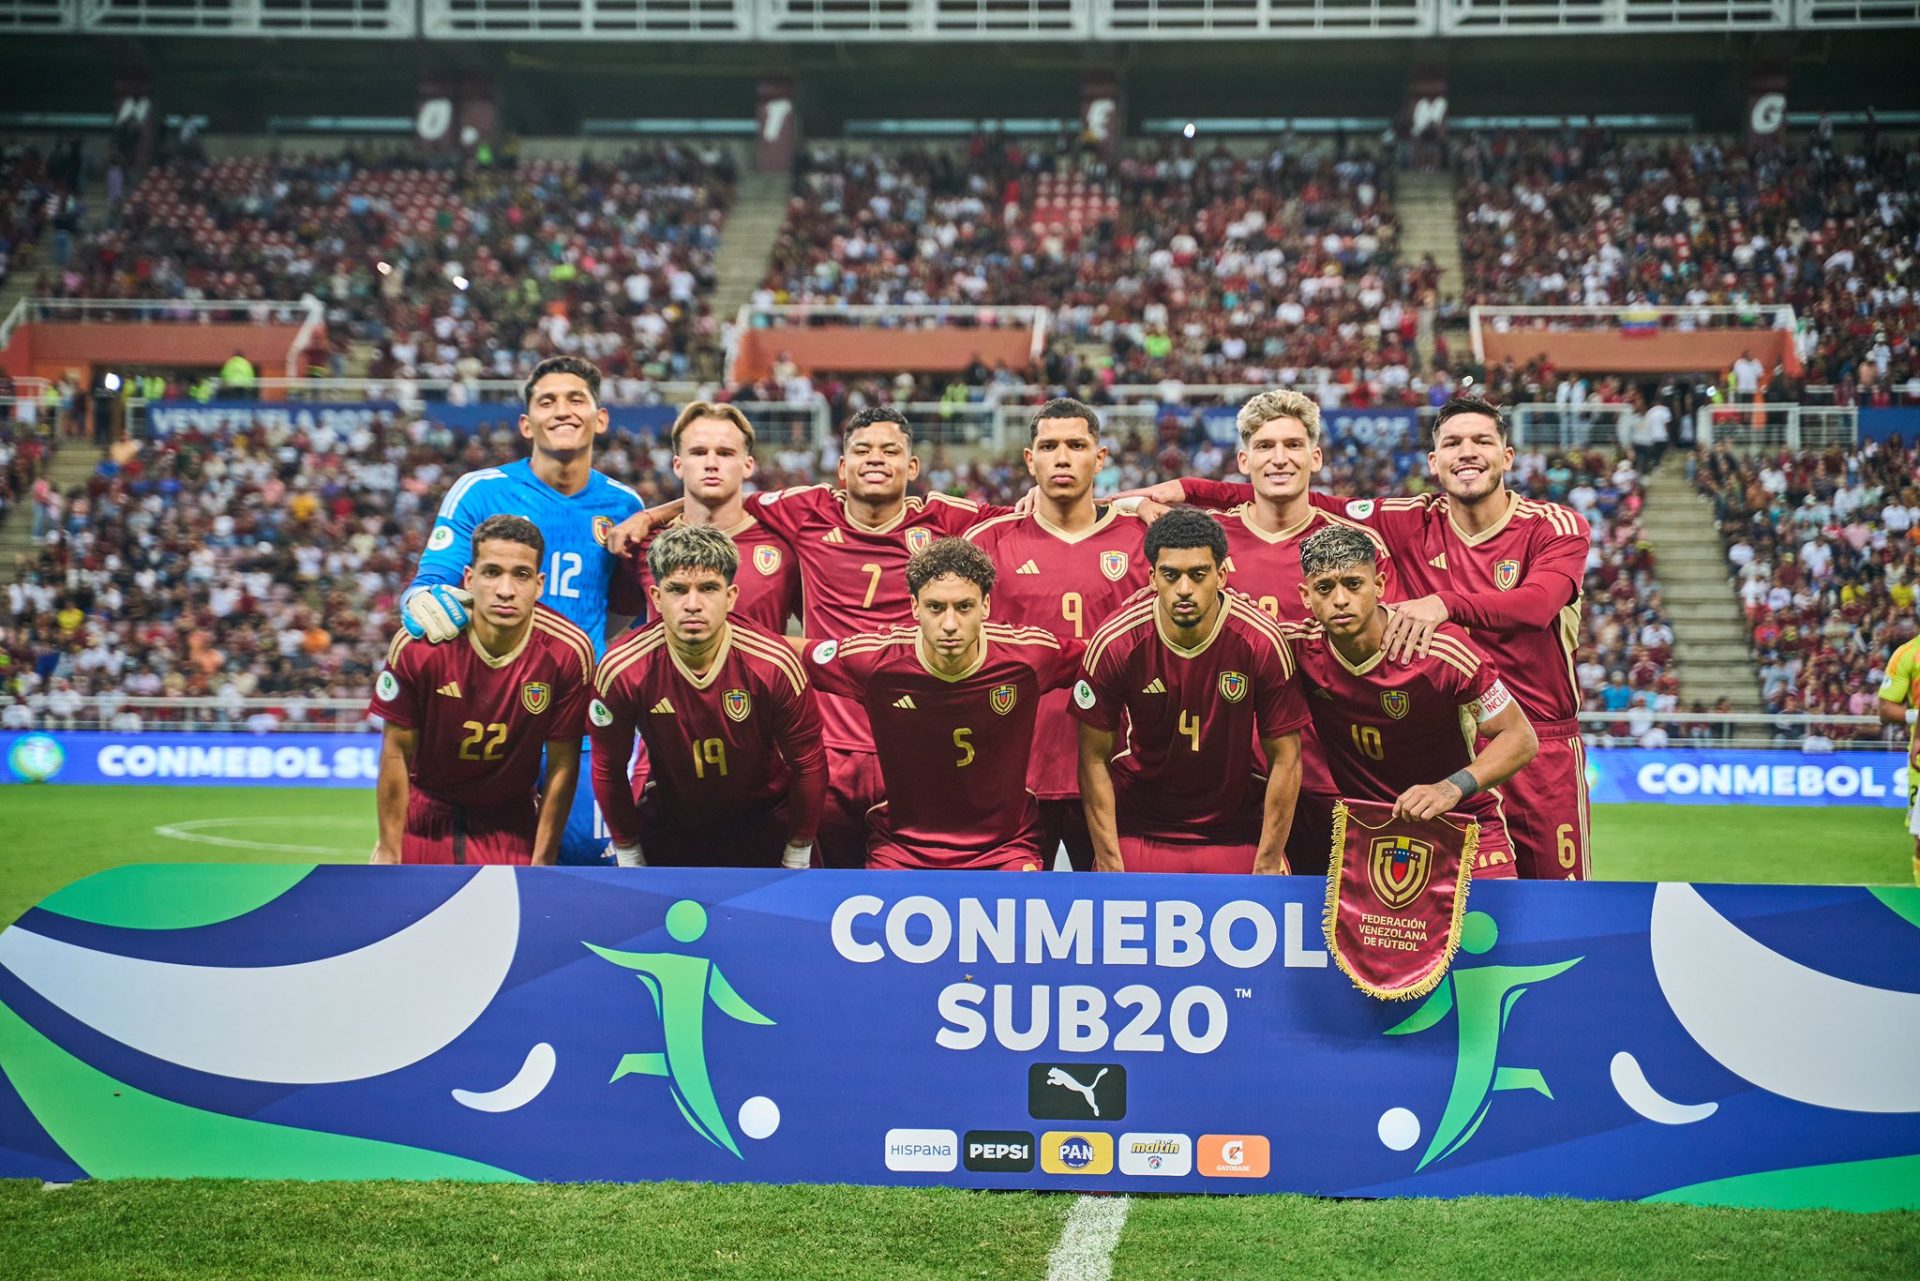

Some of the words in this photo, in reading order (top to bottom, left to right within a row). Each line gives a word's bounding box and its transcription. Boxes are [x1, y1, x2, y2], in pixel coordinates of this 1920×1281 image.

[1751, 93, 1786, 134] G
[551, 551, 582, 598] 12
[861, 563, 882, 608] 7
[1062, 592, 1083, 637] 9
[458, 720, 508, 761] 22
[952, 727, 975, 767] 5
[1178, 709, 1199, 752] 4
[1351, 723, 1384, 761] 10
[97, 744, 330, 778] CONMEBOL
[692, 737, 728, 778] 19
[1637, 762, 1886, 797] CONMEBOL
[1556, 823, 1576, 869] 6
[830, 895, 1329, 968] CONMEBOL
[1359, 924, 1428, 941] VENEZOLANA
[1361, 912, 1427, 930] FEDERACIÓN
[1363, 936, 1377, 946] DE
[1378, 938, 1419, 952] FÚTBOL
[935, 982, 1228, 1054] SUB20
[969, 1143, 1028, 1159] PEPSI
